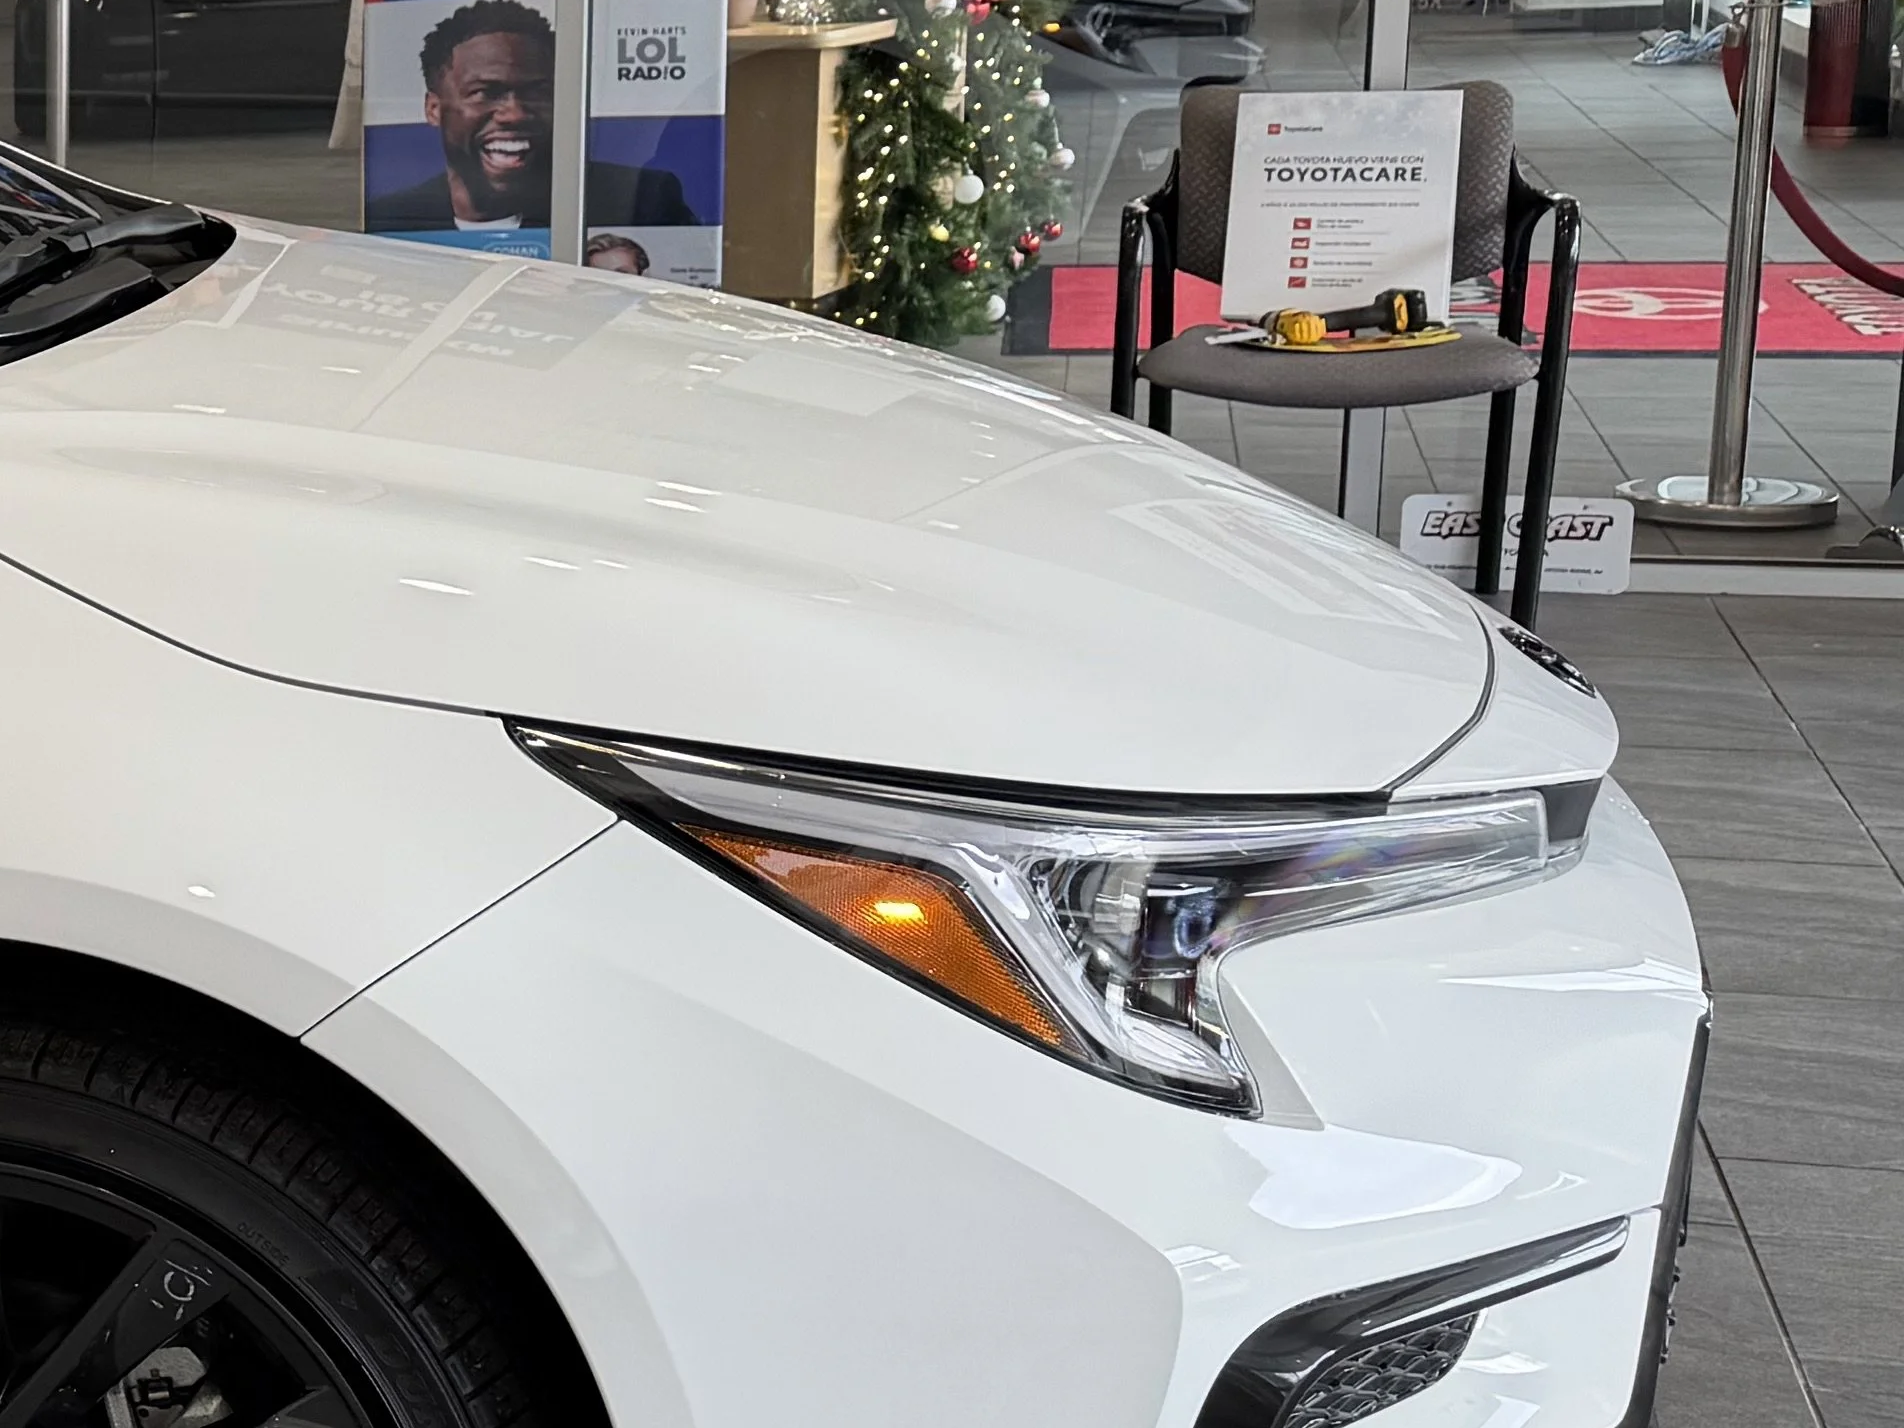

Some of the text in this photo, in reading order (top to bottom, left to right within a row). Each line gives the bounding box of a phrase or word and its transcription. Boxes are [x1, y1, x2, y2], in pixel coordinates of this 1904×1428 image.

[617, 36, 687, 65] LOL
[1263, 155, 1291, 165] CADA
[1293, 155, 1331, 164] TOYOTA
[1332, 154, 1369, 164] NUEVO
[1400, 154, 1424, 164] CON
[1263, 166, 1427, 183] TOYOTACARE.
[1420, 510, 1614, 543] EAS CAST
[237, 1222, 292, 1266] OUTSIDE
